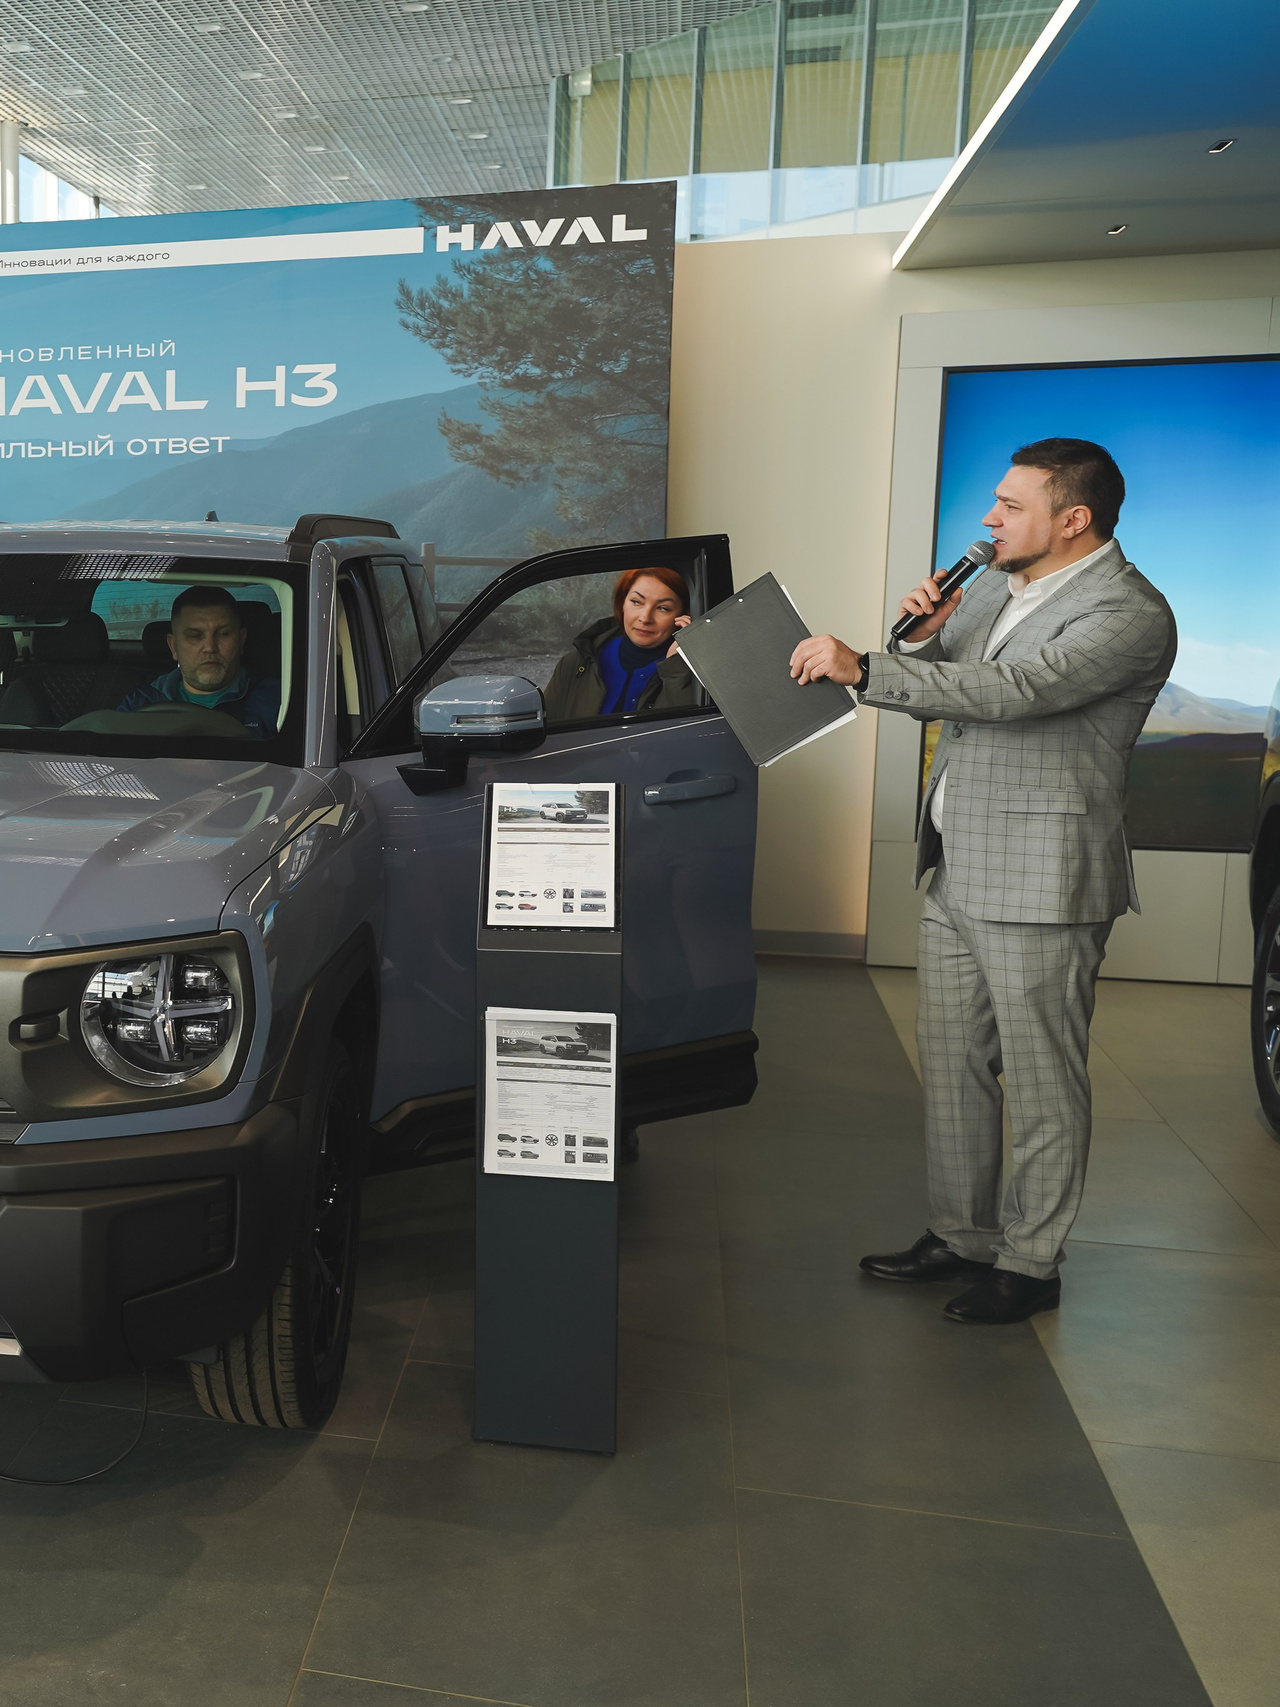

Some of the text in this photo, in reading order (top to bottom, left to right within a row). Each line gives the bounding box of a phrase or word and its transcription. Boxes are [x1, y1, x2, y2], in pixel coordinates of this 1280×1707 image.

[436, 214, 648, 252] HAVAL
[76, 256, 102, 266] для
[107, 252, 170, 264] каждого
[235, 363, 338, 409] H3
[126, 435, 231, 456] ответ
